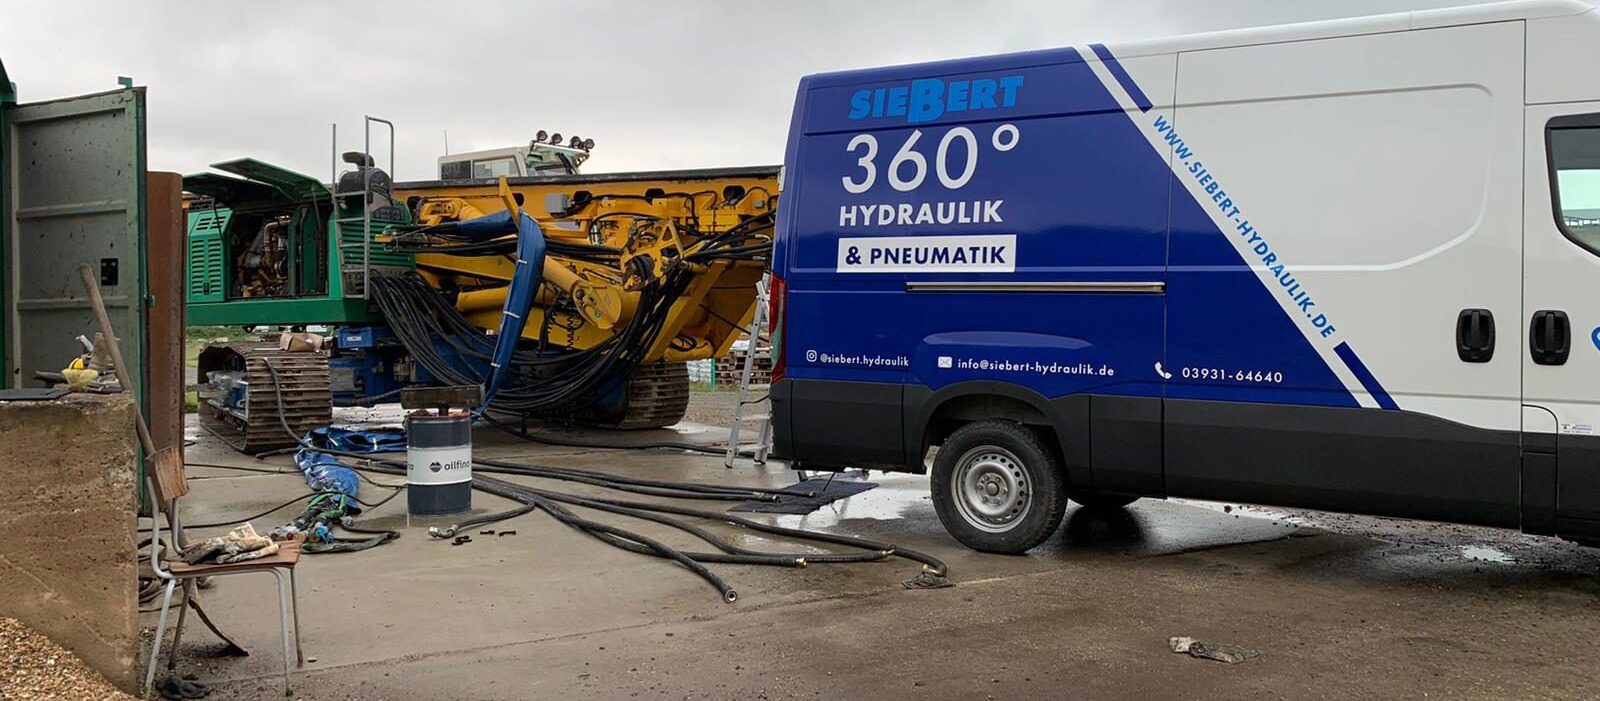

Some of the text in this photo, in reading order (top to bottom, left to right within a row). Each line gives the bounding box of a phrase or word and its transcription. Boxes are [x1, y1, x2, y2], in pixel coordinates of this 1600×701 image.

[848, 75, 1024, 123] SIEBERT
[839, 201, 1004, 227] HYDRAULIK
[1153, 115, 1336, 338] WWW.SIEBERT-HYDRAULIK.DE
[845, 245, 1006, 265] & PNEUMATIK
[820, 353, 909, 367] @siebert.hydraulik
[957, 358, 1114, 376] info@siebert-hydraulik.de
[1182, 367, 1283, 383] 03931-64640
